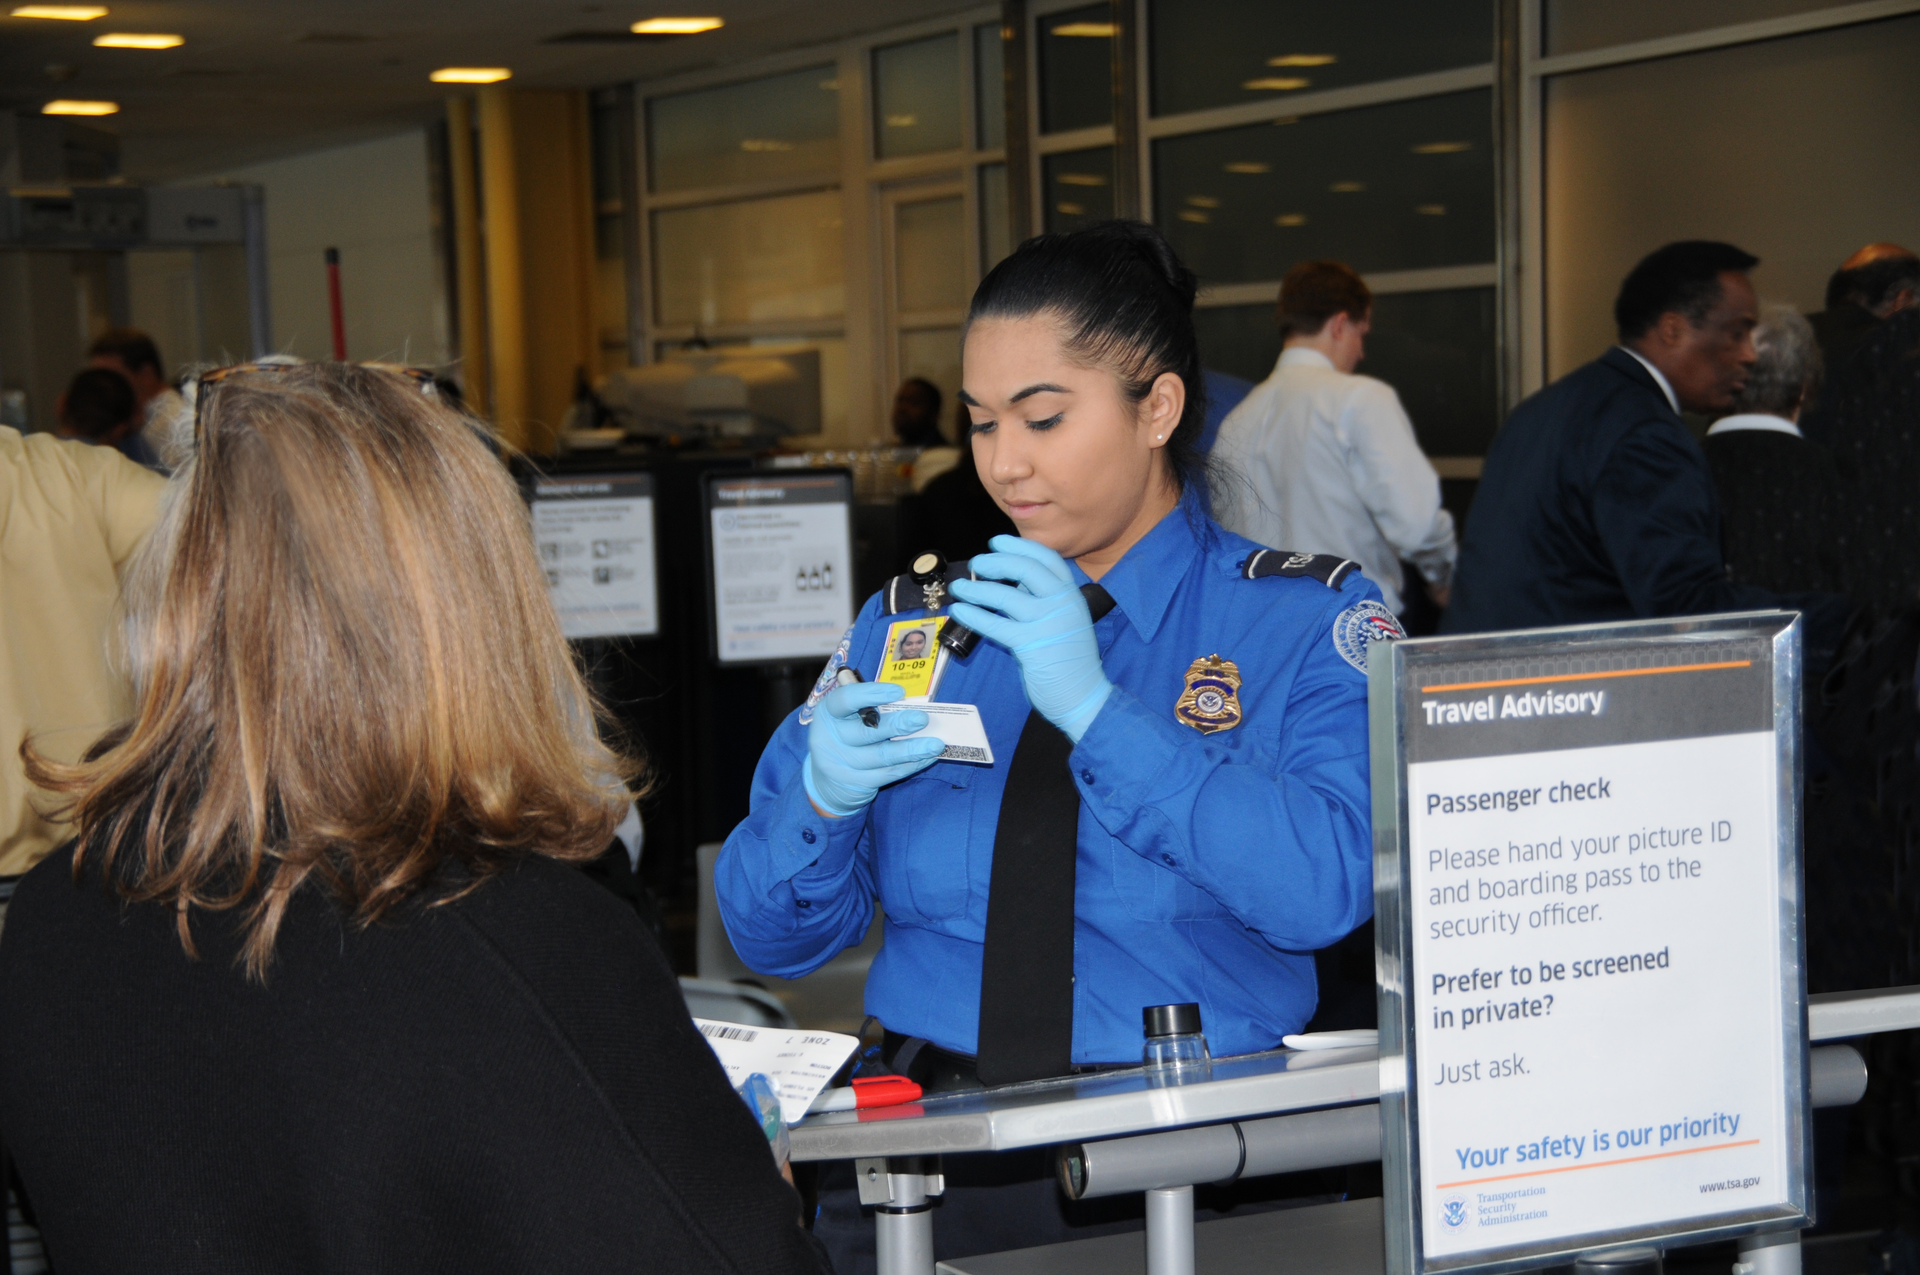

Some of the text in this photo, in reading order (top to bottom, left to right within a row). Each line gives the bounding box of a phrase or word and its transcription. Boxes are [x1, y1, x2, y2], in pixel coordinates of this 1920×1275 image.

[892, 660, 926, 671] 10-09
[1422, 690, 1604, 725] Travel Advisory
[1427, 777, 1611, 815] Passenger check
[1429, 820, 1732, 872] Please hand your picture ID
[1430, 857, 1701, 905] and boarding pass to the
[1430, 902, 1602, 940] security officer.
[1432, 946, 1669, 996] Prefer to be screened
[1433, 994, 1554, 1030] in private?
[801, 1036, 830, 1045] ZONE
[1434, 1053, 1531, 1086] Just ask.
[1455, 1112, 1741, 1170] Your safety is our priority
[1477, 1186, 1546, 1203] Transportation
[1699, 1175, 1761, 1194] www.tsa.gov
[1477, 1201, 1517, 1216] Security
[1477, 1209, 1548, 1227] Administration
